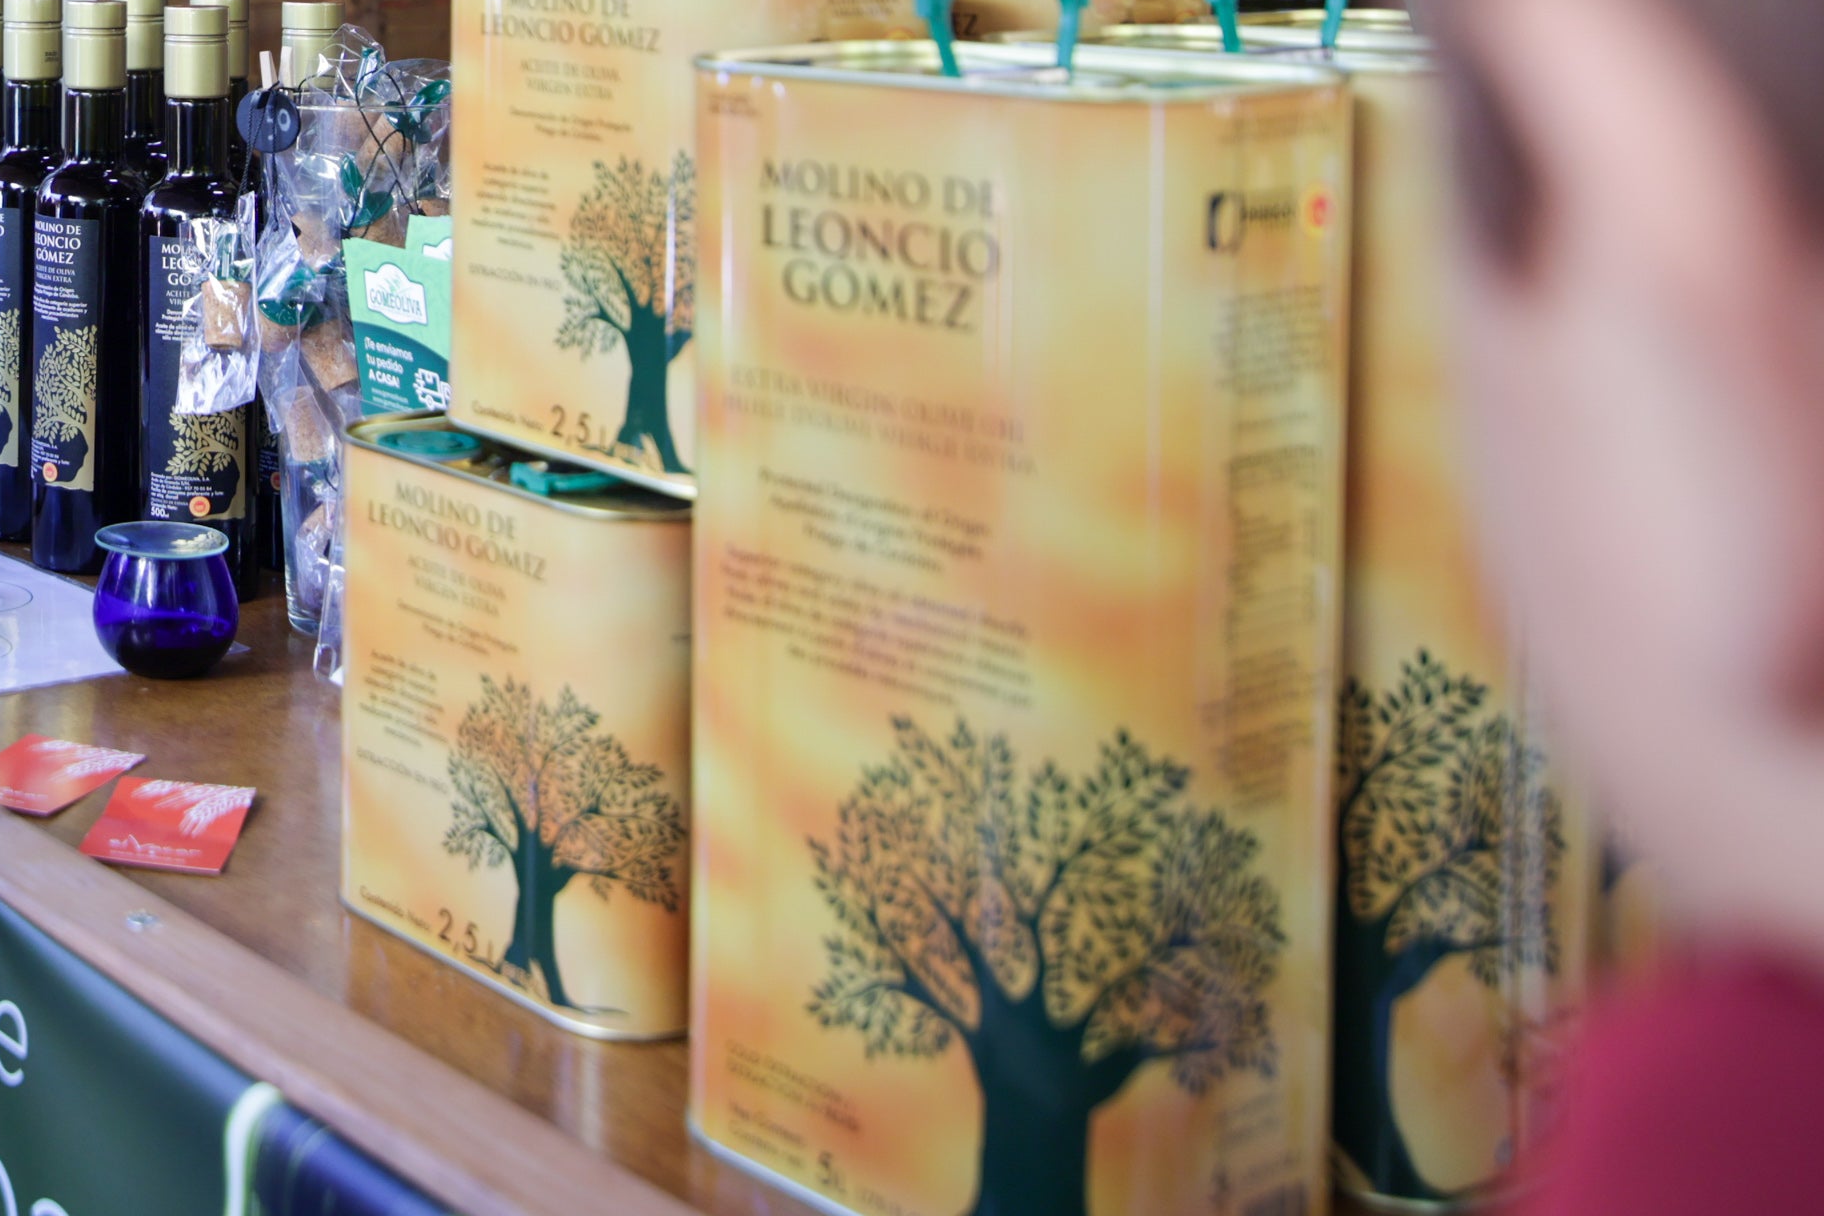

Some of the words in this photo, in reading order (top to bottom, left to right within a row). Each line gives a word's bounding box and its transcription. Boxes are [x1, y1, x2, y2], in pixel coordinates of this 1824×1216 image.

[480, 13, 576, 46] LEONCIO
[761, 159, 933, 211] MOLINO
[940, 175, 996, 219] DE
[66, 224, 82, 236] DE
[761, 204, 1001, 281] LEONCIO
[36, 246, 74, 265] GÓMEZ
[56, 268, 76, 276] OLIVA
[52, 275, 73, 284] EXTRA
[369, 287, 423, 317] GOMEOLIVA
[369, 368, 376, 381] A
[550, 404, 591, 447] 2,5
[367, 499, 462, 552] LEONCIO
[395, 479, 482, 528] MOLINO
[487, 509, 518, 541] DE
[437, 907, 479, 955] 2,5
